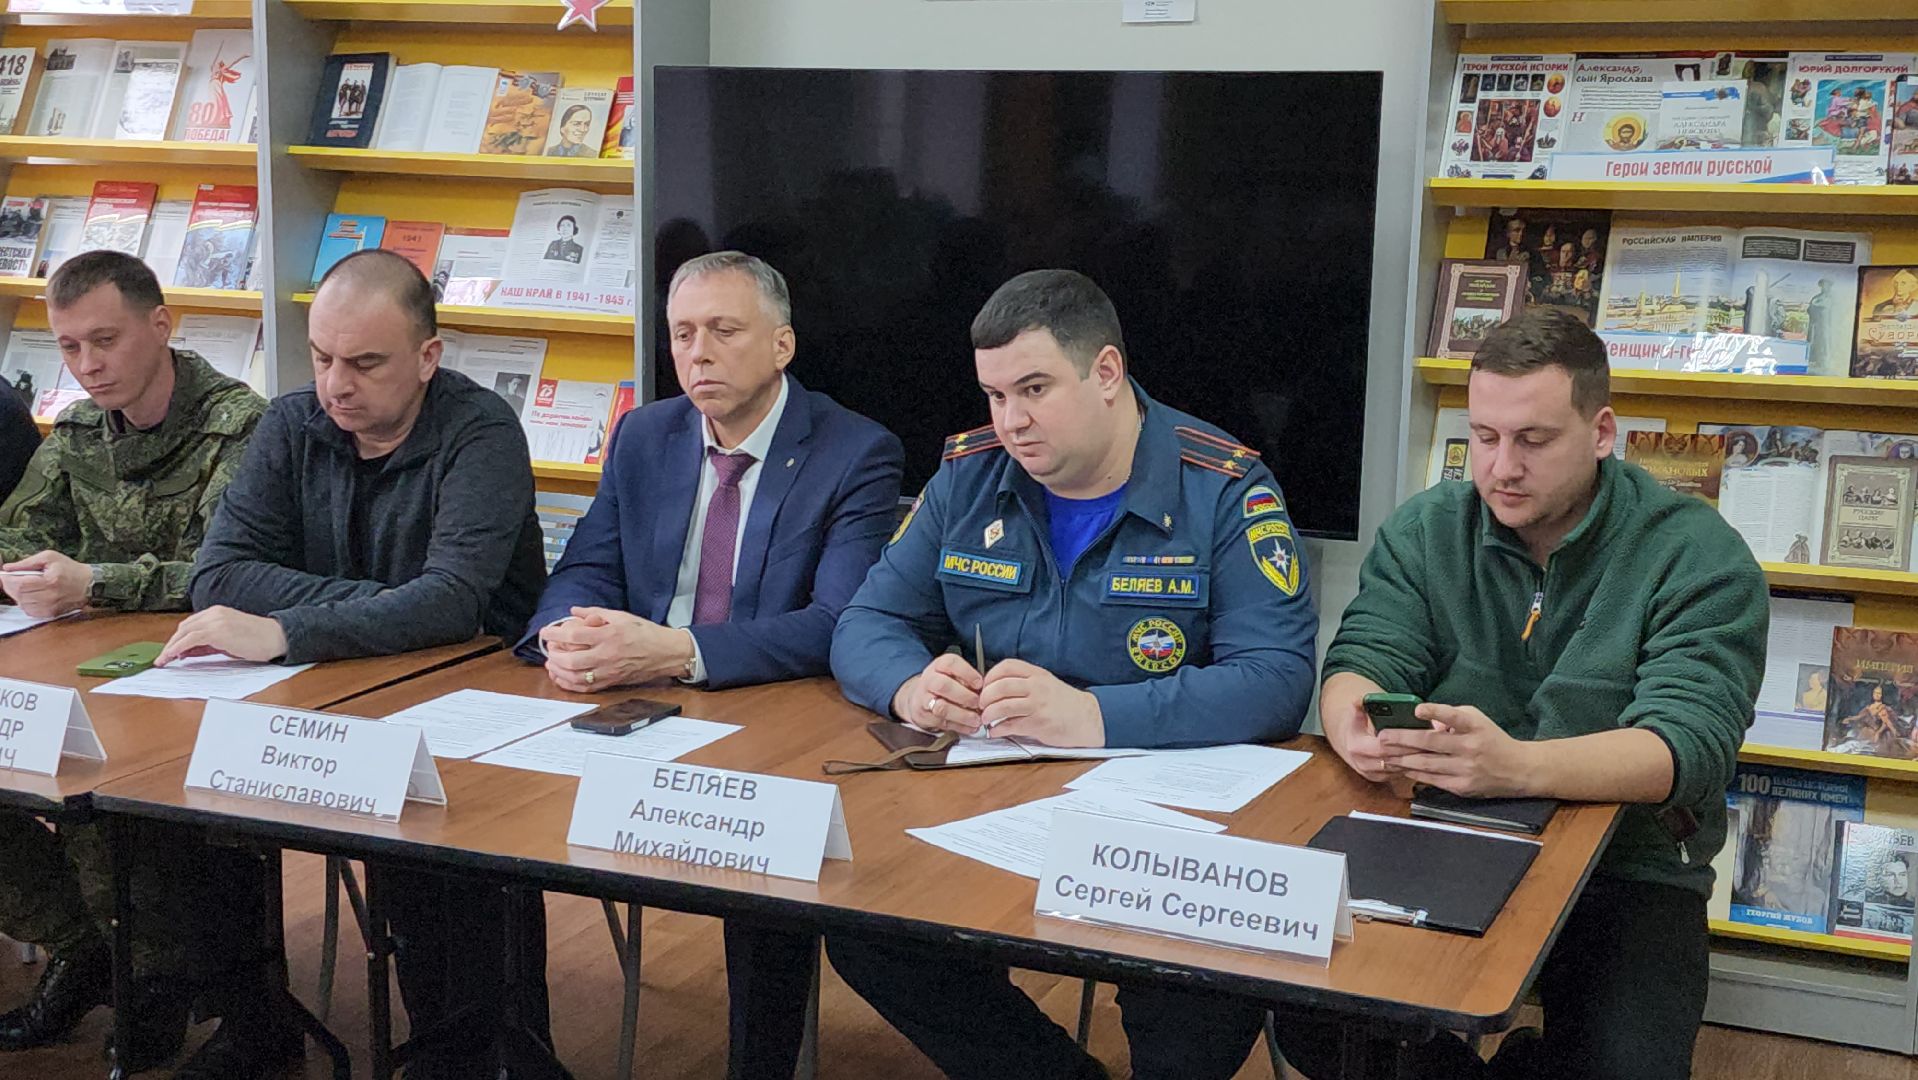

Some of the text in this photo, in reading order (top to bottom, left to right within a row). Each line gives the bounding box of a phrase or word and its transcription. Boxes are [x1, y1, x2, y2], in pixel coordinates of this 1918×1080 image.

[1529, 63, 1569, 71] ИСТОРИИ
[1599, 74, 1653, 85] Ярослава
[1799, 64, 1909, 74] ЮРИЙ ДОЛГОРУКИЙ
[1606, 156, 1773, 179] Герои земли русской
[500, 287, 524, 297] НАШ
[525, 287, 553, 299] КРАЙ
[566, 291, 591, 302] 1941
[944, 554, 1018, 580] МЧС РОССИИ
[1111, 577, 1195, 594] БЕЛЯЕВ А.М.
[268, 713, 350, 744] СЕМИН
[260, 745, 338, 778] Виктор
[209, 769, 378, 815] Станиславович
[653, 767, 758, 801] БЕЛЯЕВ
[1738, 772, 1771, 796] 100
[629, 798, 766, 842] Александр
[613, 830, 770, 873] Михайлович
[1091, 843, 1290, 898] КОЛЫВАНОВ
[1055, 874, 1320, 941] Сергей Сергеевич
